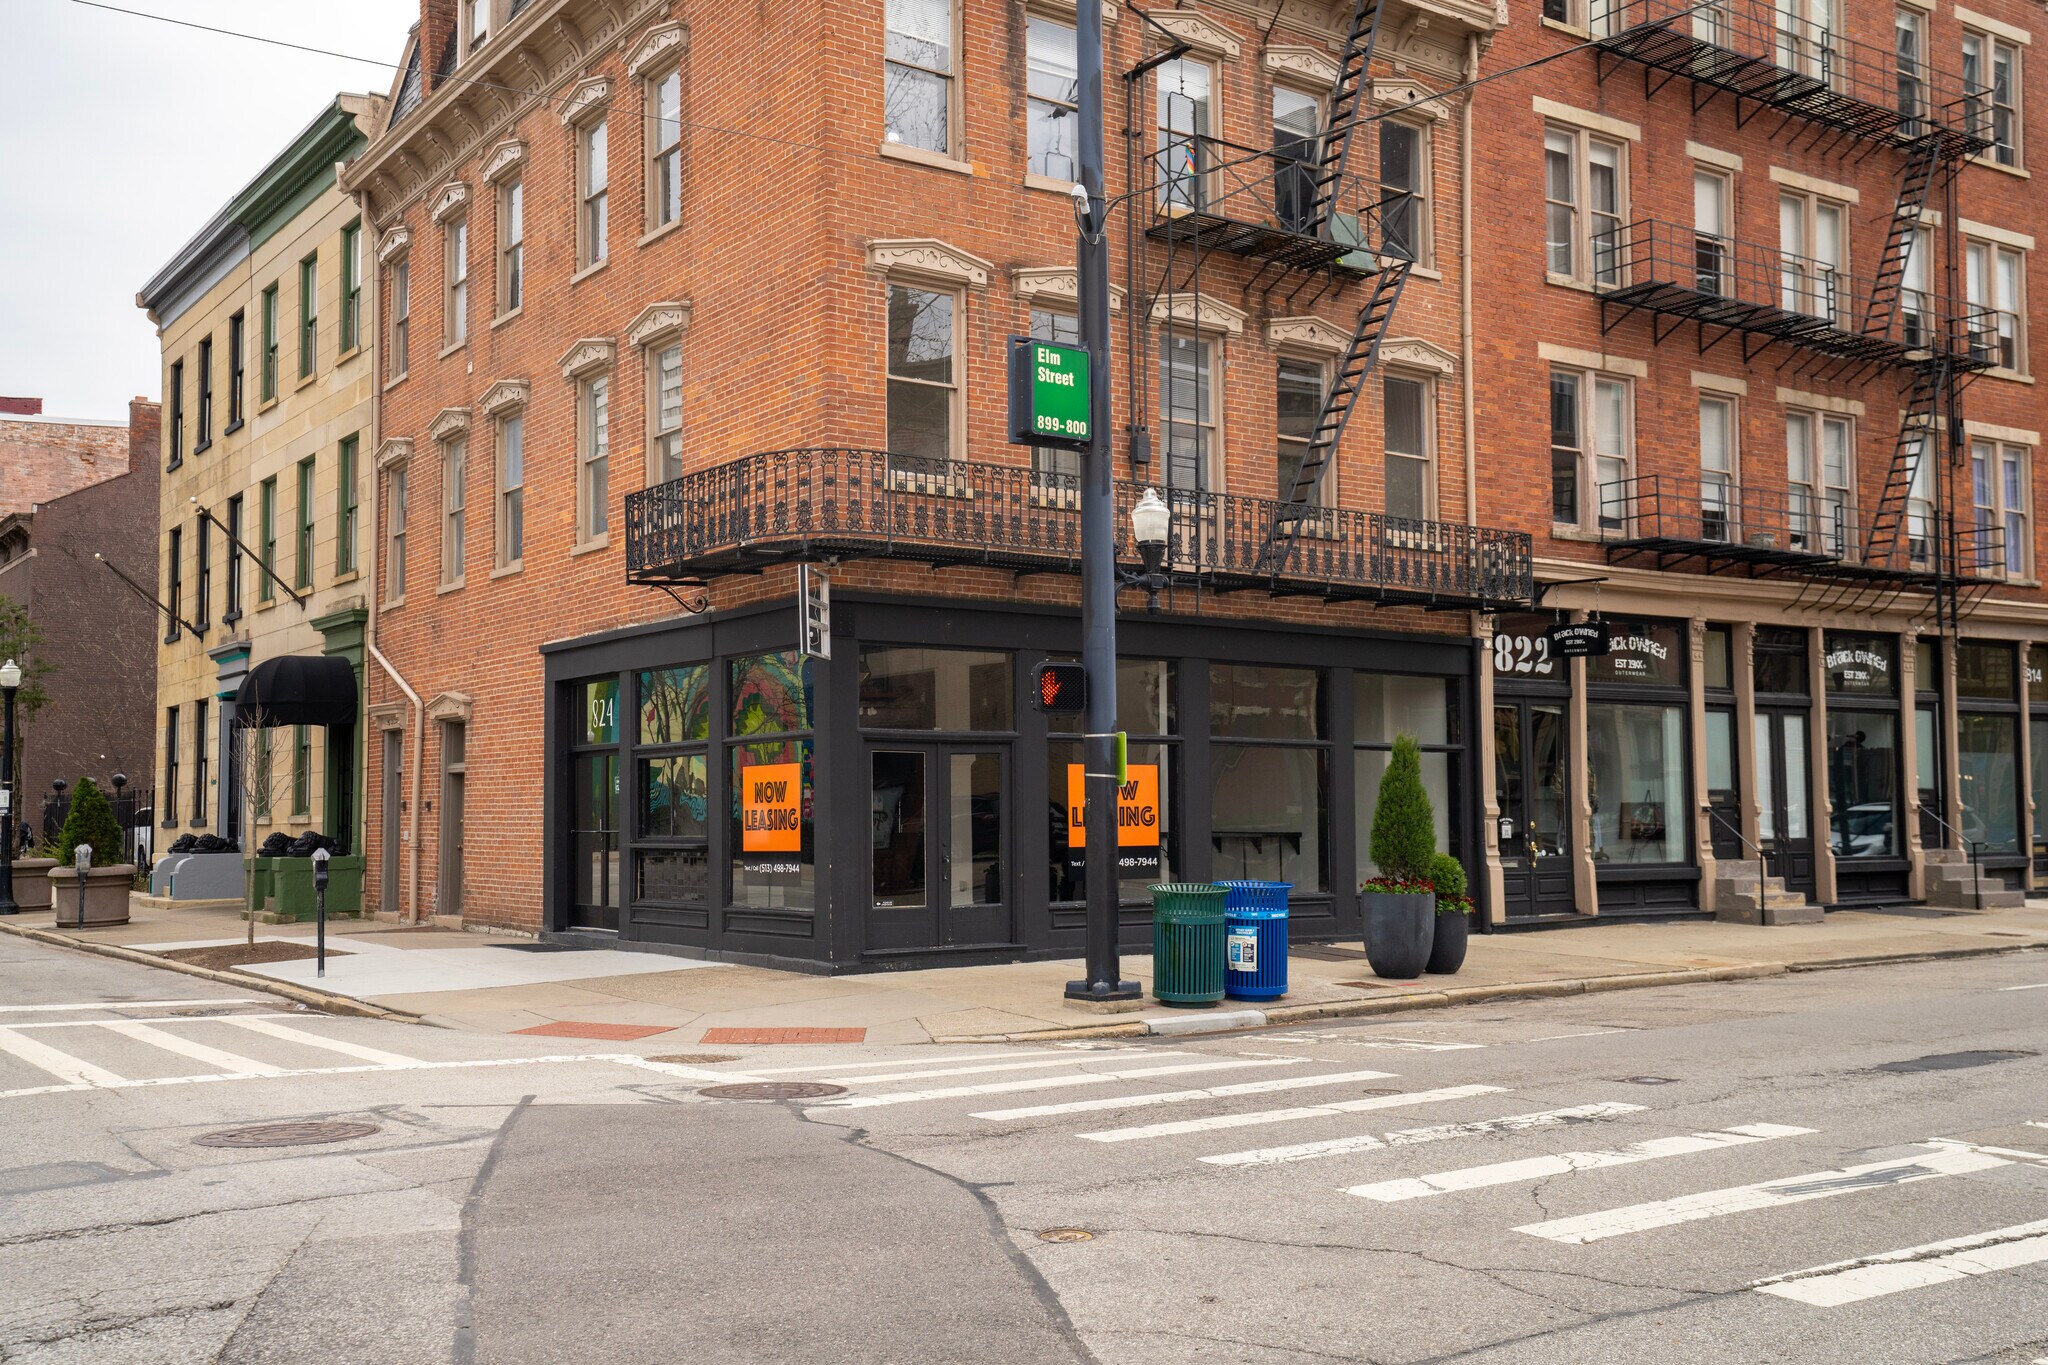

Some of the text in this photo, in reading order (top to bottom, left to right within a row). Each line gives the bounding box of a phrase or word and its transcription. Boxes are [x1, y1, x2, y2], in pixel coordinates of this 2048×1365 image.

[1037, 347, 1061, 366] Elm
[1037, 366, 1075, 387] Street
[1037, 415, 1087, 436] 899-800
[1494, 634, 1553, 674] 822
[1614, 658, 1628, 668] EST
[1843, 670, 1854, 679] EST
[592, 697, 613, 728] 824
[754, 781, 787, 803] NOW
[744, 808, 799, 831] LEASING
[1072, 805, 1156, 828] LING
[759, 863, 773, 873] (513)
[773, 863, 800, 873] 498-7944
[1118, 857, 1158, 867] 498-7944
